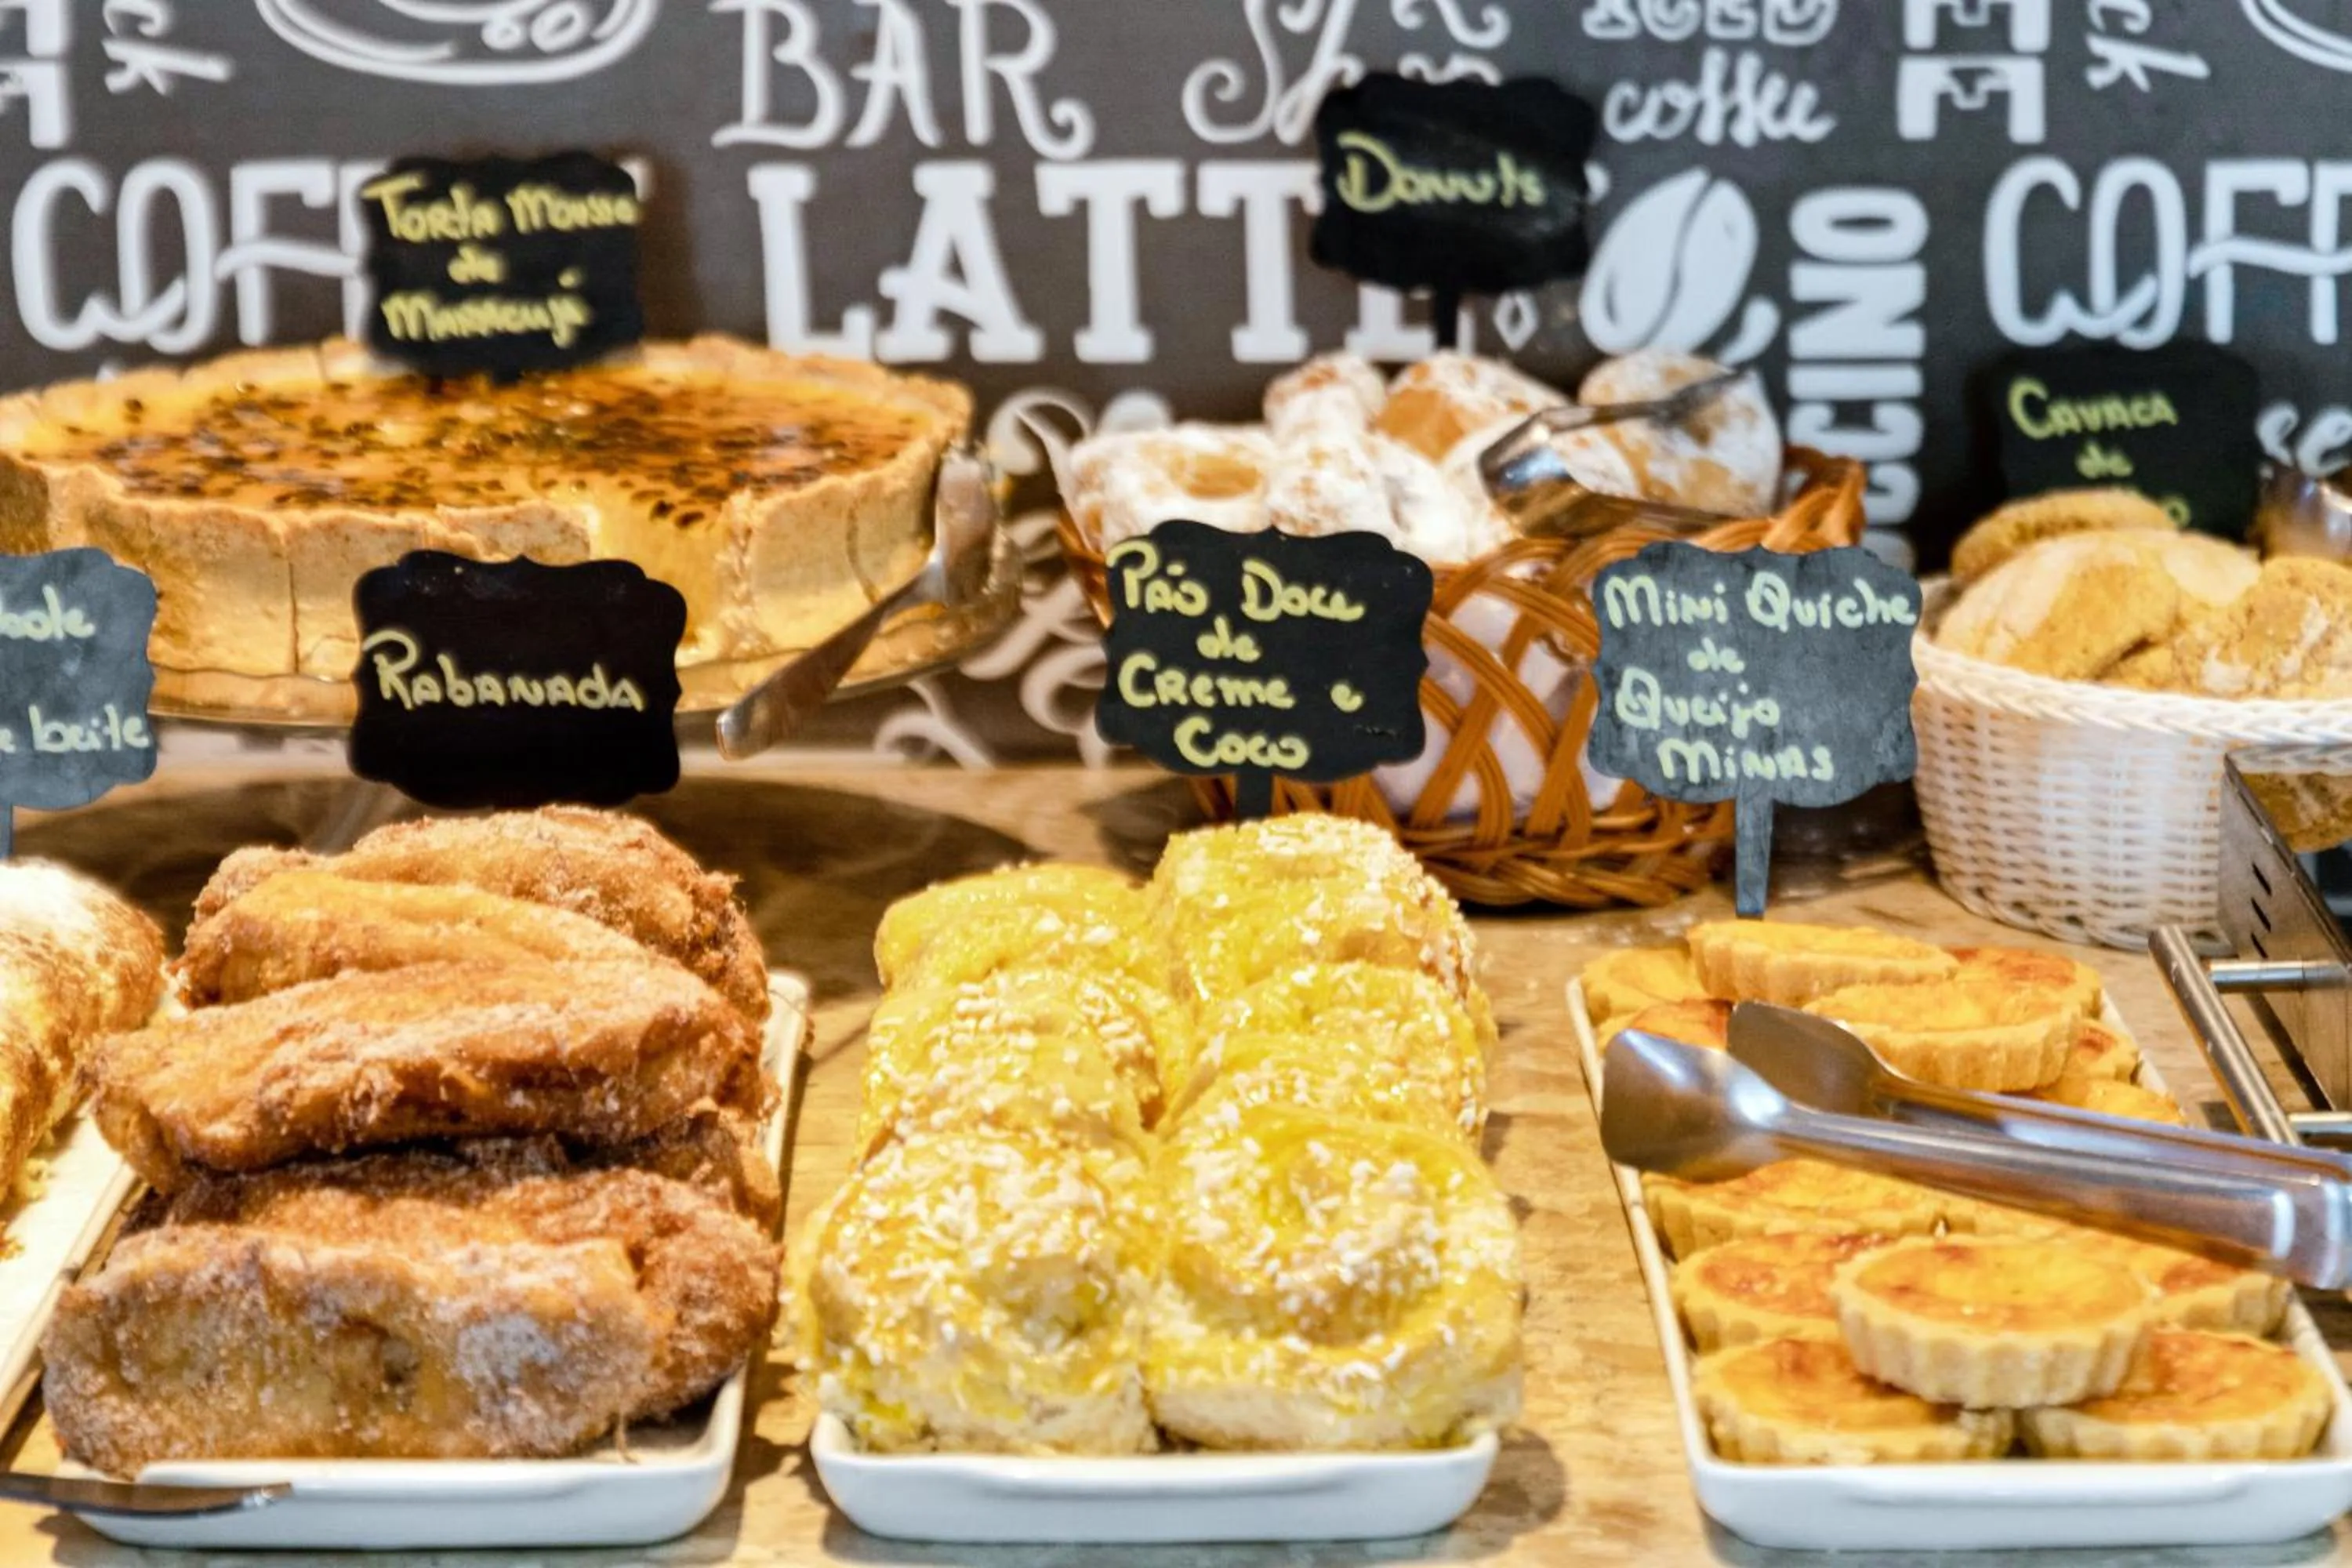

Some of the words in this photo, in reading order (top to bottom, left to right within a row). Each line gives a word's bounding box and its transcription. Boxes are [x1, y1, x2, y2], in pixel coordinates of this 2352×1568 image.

[1337, 132, 1546, 212] Donuts
[746, 161, 1474, 364] LATT
[2009, 377, 2178, 439] Cavaca
[2077, 445, 2132, 478] de
[1241, 560, 1365, 622] Doce
[1604, 575, 1729, 629] Mini
[1746, 571, 1917, 632] Quiche
[1197, 615, 1260, 662] de
[1687, 637, 1745, 673] de
[364, 631, 644, 710] Rabanada
[1118, 653, 1294, 709] Creme
[1331, 681, 1363, 712] e
[1615, 666, 1780, 739] Queijo
[1174, 716, 1309, 768] Coco
[1657, 738, 1835, 783] Minas
